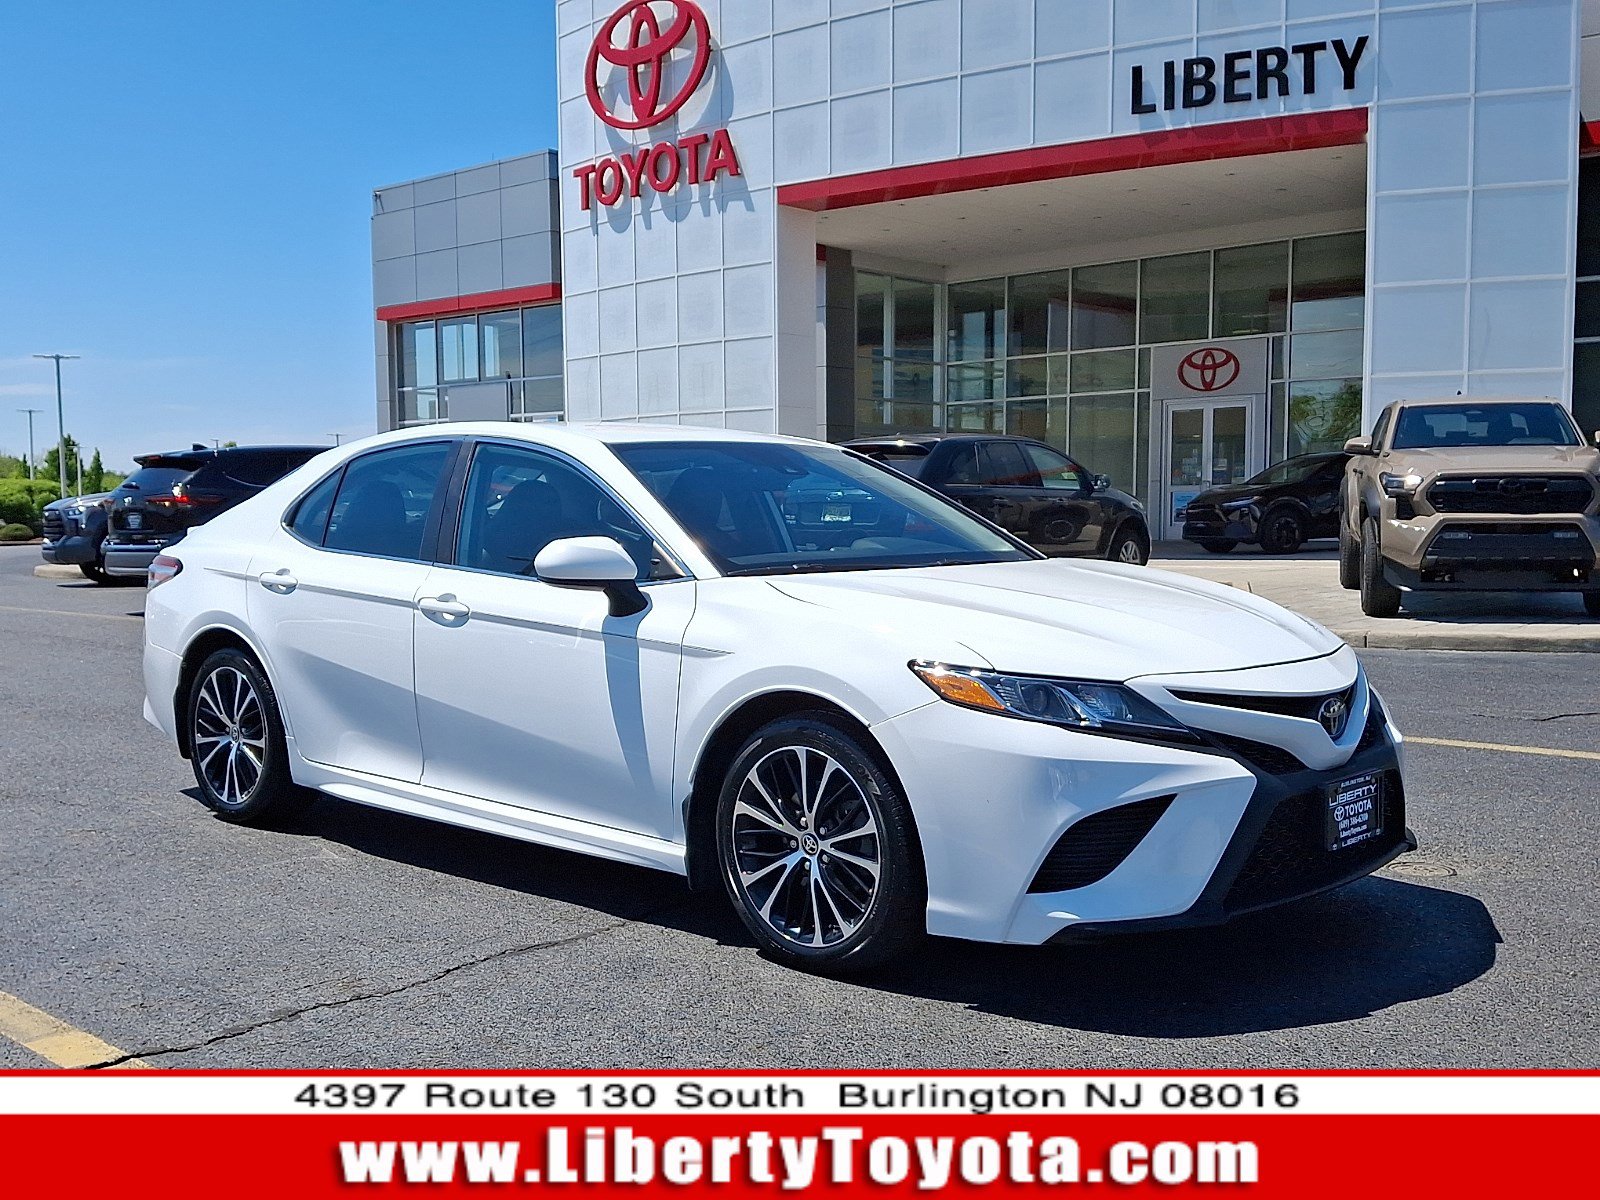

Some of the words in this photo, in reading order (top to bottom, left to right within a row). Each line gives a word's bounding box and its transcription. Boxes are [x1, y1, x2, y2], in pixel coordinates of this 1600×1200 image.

[1131, 35, 1369, 115] LIBERTY
[573, 128, 741, 211] TOYOTA
[1329, 783, 1377, 806] LIBERTY
[1345, 799, 1372, 817] TOYOTA
[1341, 831, 1372, 847] LIBERTY
